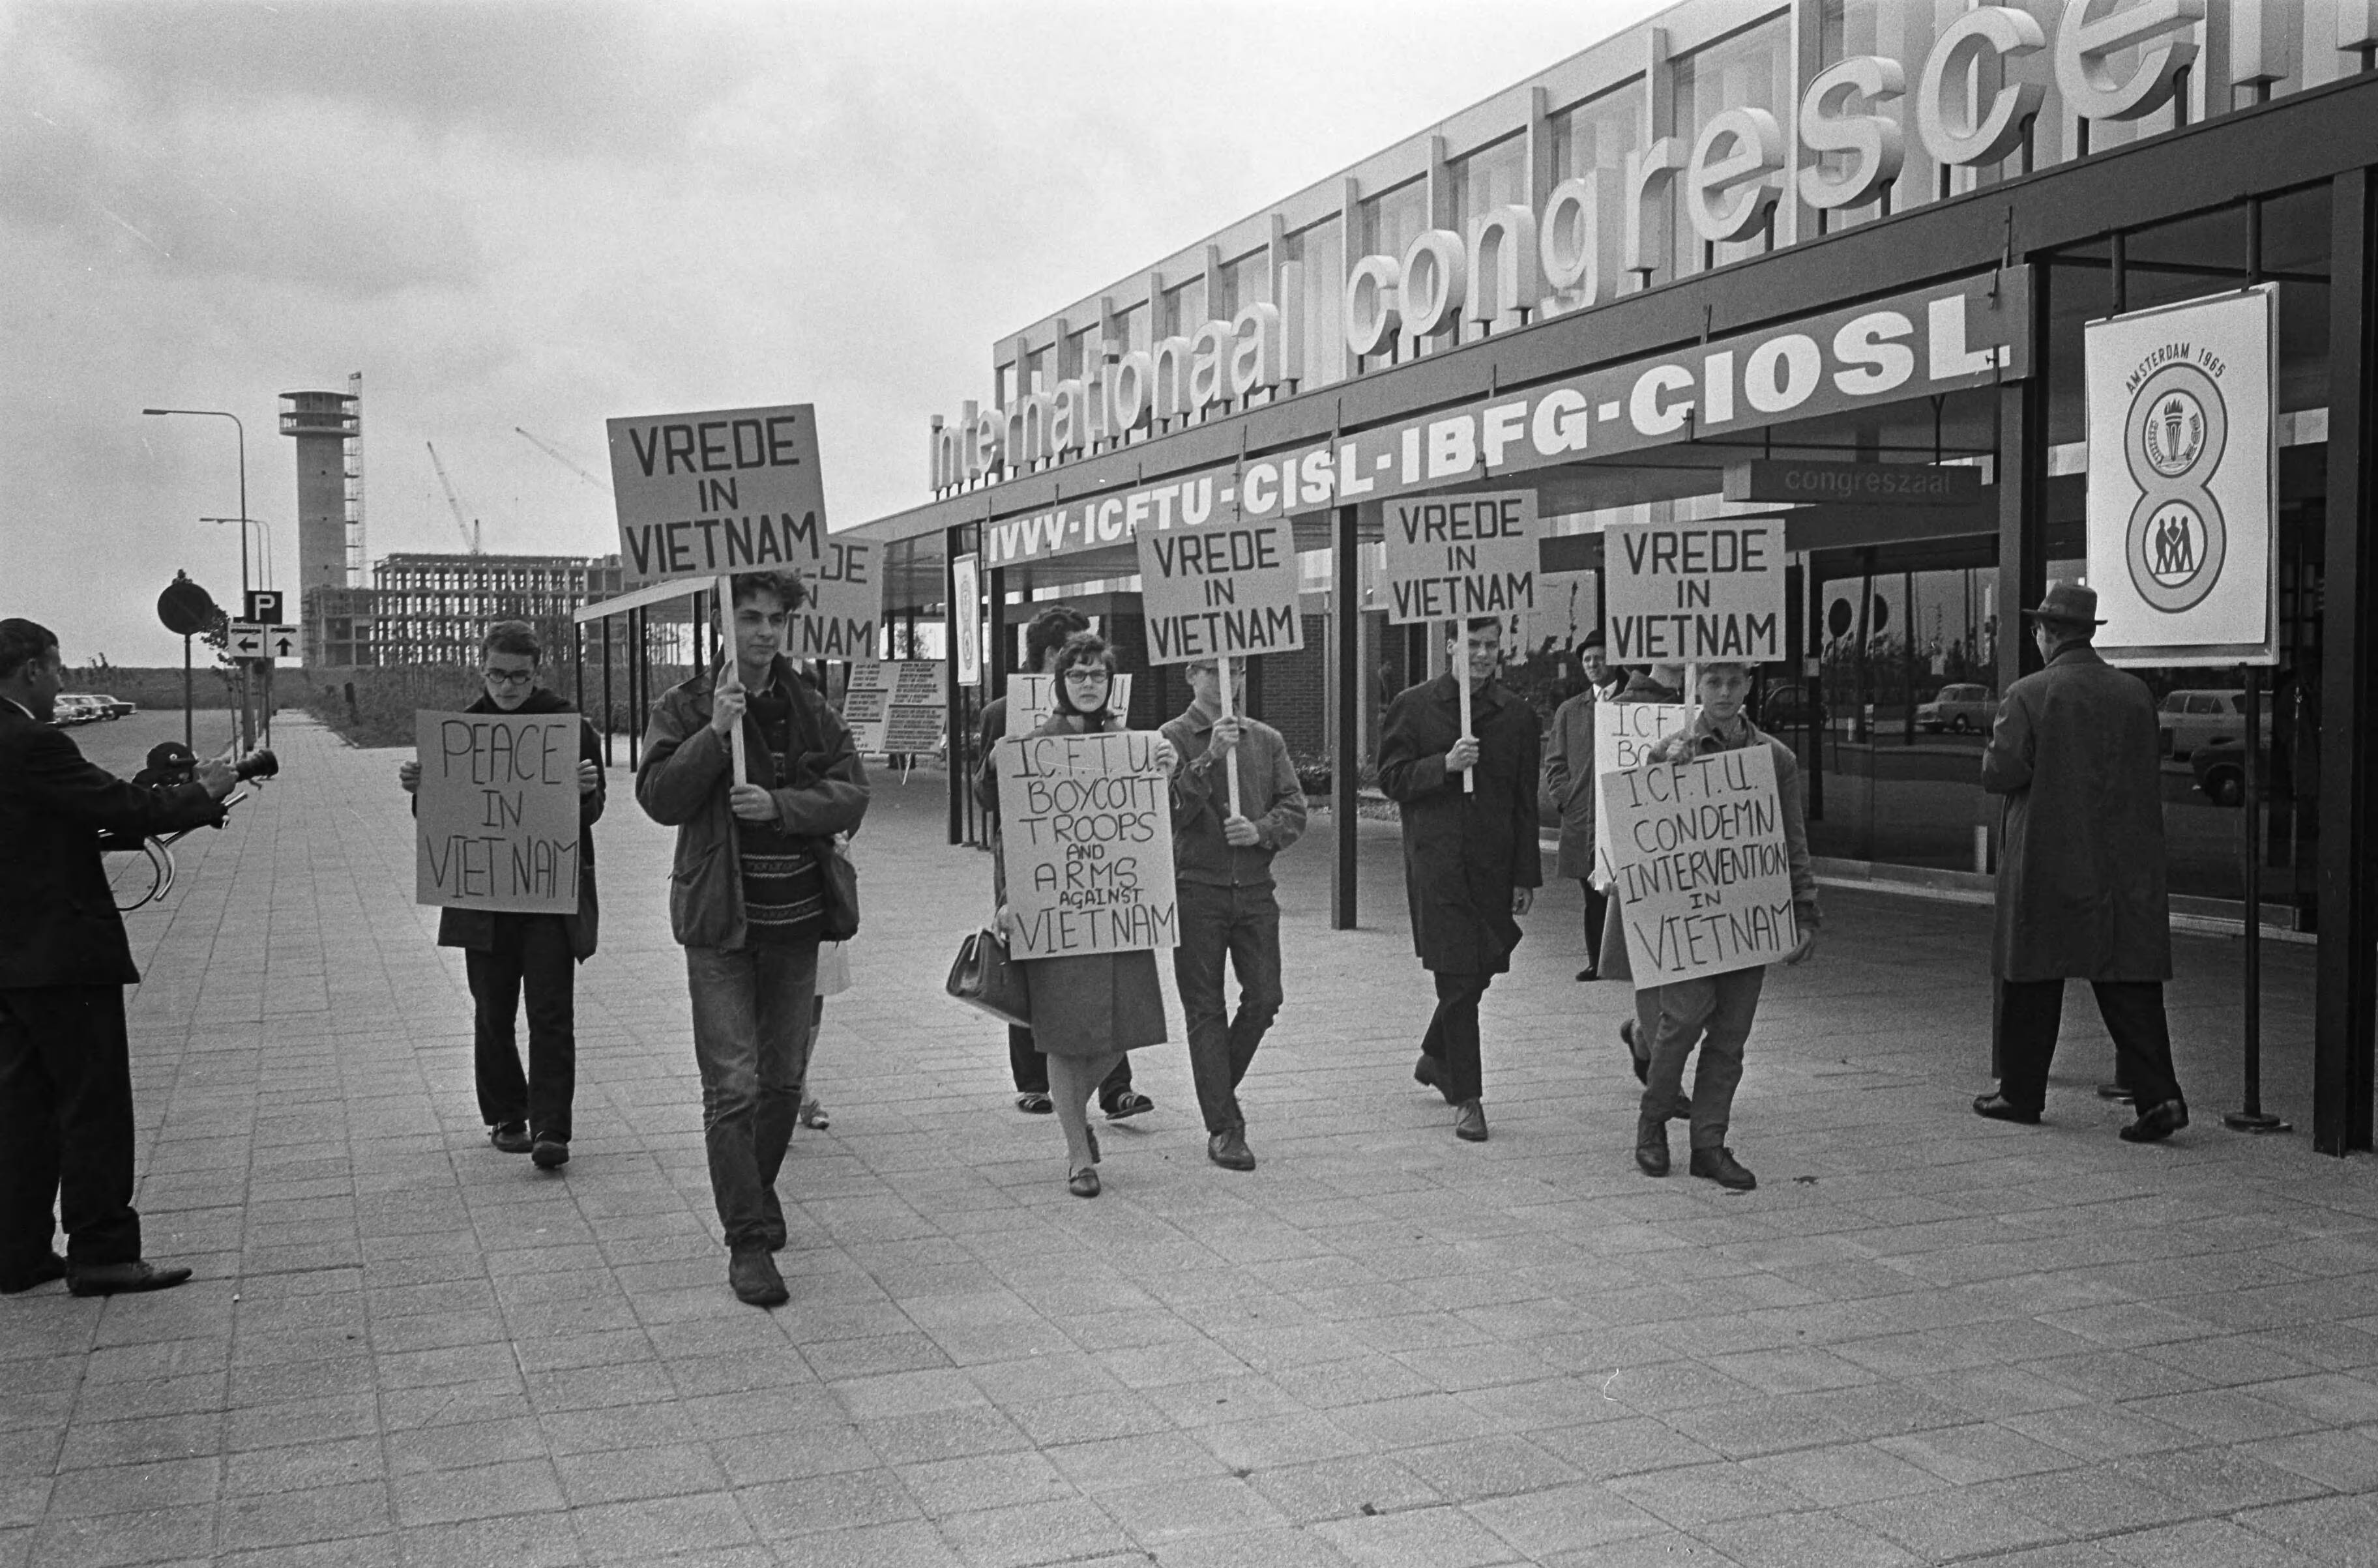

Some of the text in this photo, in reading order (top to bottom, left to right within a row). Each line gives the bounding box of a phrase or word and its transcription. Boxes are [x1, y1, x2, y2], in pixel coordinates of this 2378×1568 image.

[930, 261, 1302, 492] internationaal
[2126, 342, 2226, 395] AMSTERDAM 1965
[629, 415, 800, 477] VREDE
[698, 476, 739, 513] IN
[1784, 469, 1950, 498] congreszaal
[626, 510, 820, 575] VIETNAM
[1399, 499, 1524, 544] VREDE
[1152, 527, 1280, 578] VREDE
[1446, 544, 1476, 572] IN
[1623, 529, 1768, 575] VREDE
[255, 594, 276, 621] P
[1204, 577, 1235, 606] IN
[1392, 571, 1534, 618] VIETNAM
[1677, 579, 1710, 609] IN
[1151, 604, 1295, 658] VIETNAM
[1611, 612, 1776, 659] VIETNAM
[441, 719, 566, 785] PEACE
[480, 790, 522, 830] IN
[1028, 775, 1164, 814] BOYCOTT
[1018, 811, 1158, 845] TROOPS
[1633, 794, 1775, 853] CONDEMN
[1035, 857, 1138, 892] ARMS
[1066, 843, 1105, 861] AND
[1620, 842, 1788, 905] INTERVENTION
[1059, 888, 1145, 909] AGAINST
[1689, 890, 1722, 910] IN
[1015, 901, 1178, 954] VIETNAM
[1633, 898, 1795, 972] VIETNAM
